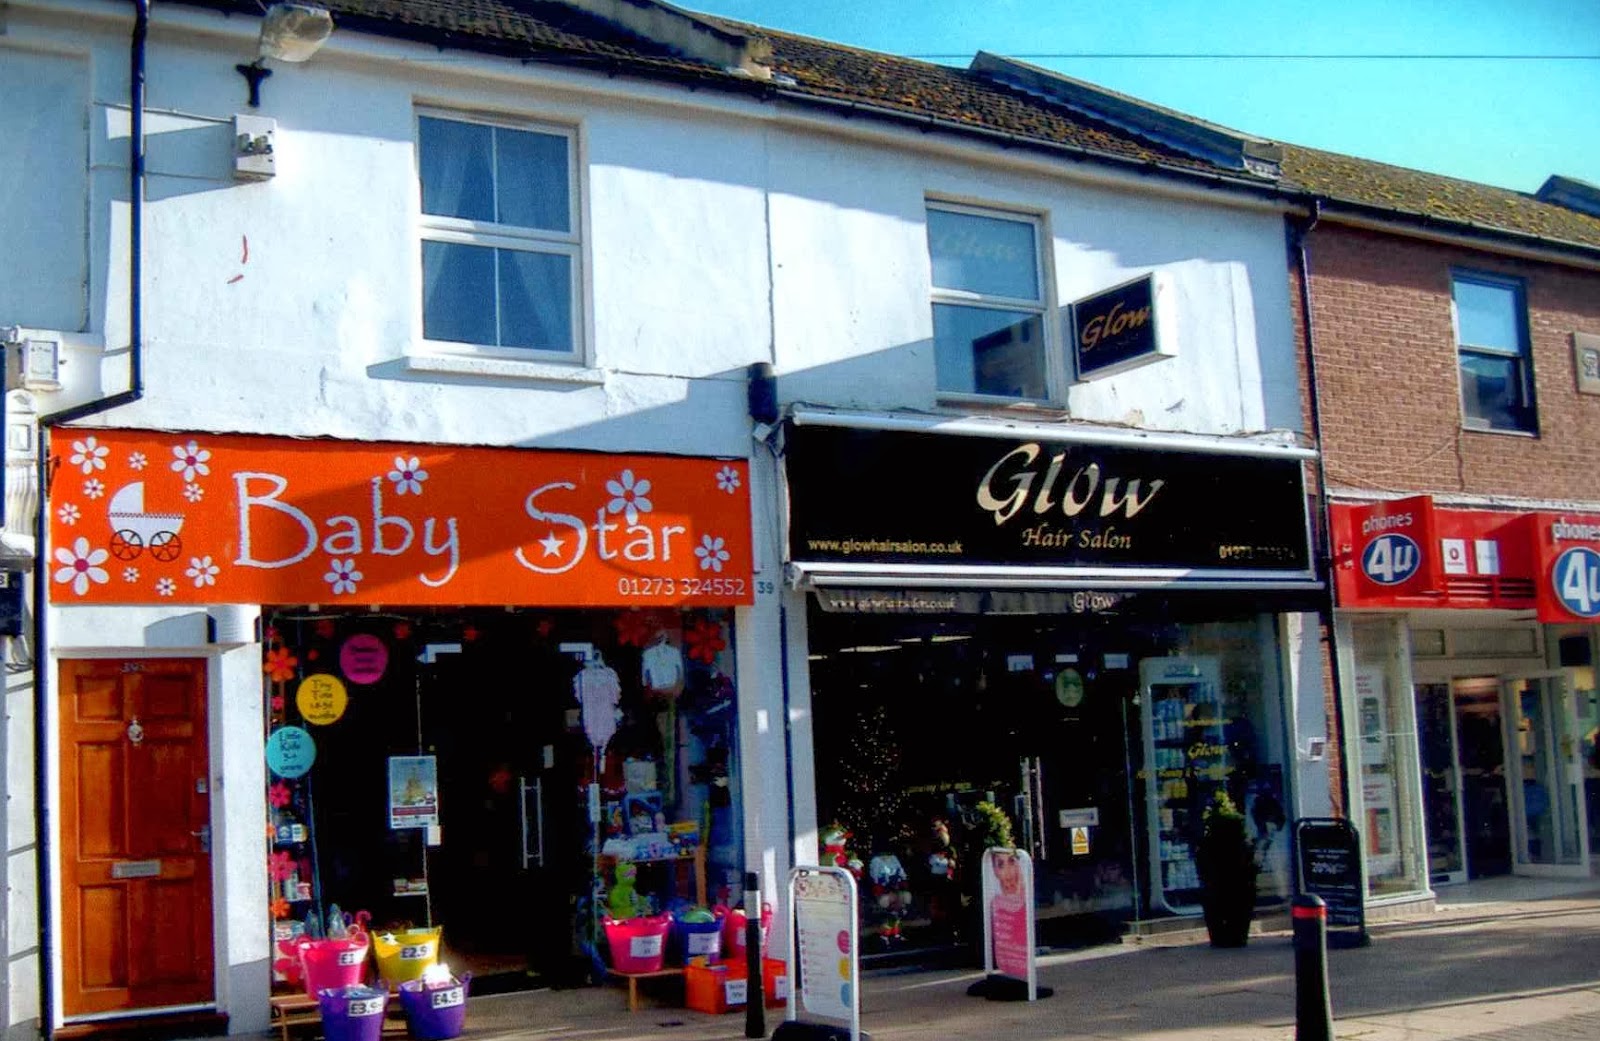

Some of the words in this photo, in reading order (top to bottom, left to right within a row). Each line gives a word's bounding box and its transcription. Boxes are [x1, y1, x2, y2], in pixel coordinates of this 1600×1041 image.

[1080, 300, 1150, 353] Glow
[975, 442, 1165, 526] Glow
[231, 471, 460, 588] Baby
[514, 481, 686, 574] Star
[1022, 522, 1074, 548] Hair
[1078, 526, 1133, 549] Salon
[1362, 512, 1413, 536] phones
[1552, 516, 1600, 544] phone
[807, 538, 964, 554] www.glowhairsalon.co.uk
[618, 577, 676, 596] 01273
[680, 577, 746, 596] 324552
[757, 581, 775, 595] 39
[1073, 590, 1115, 613] Glow
